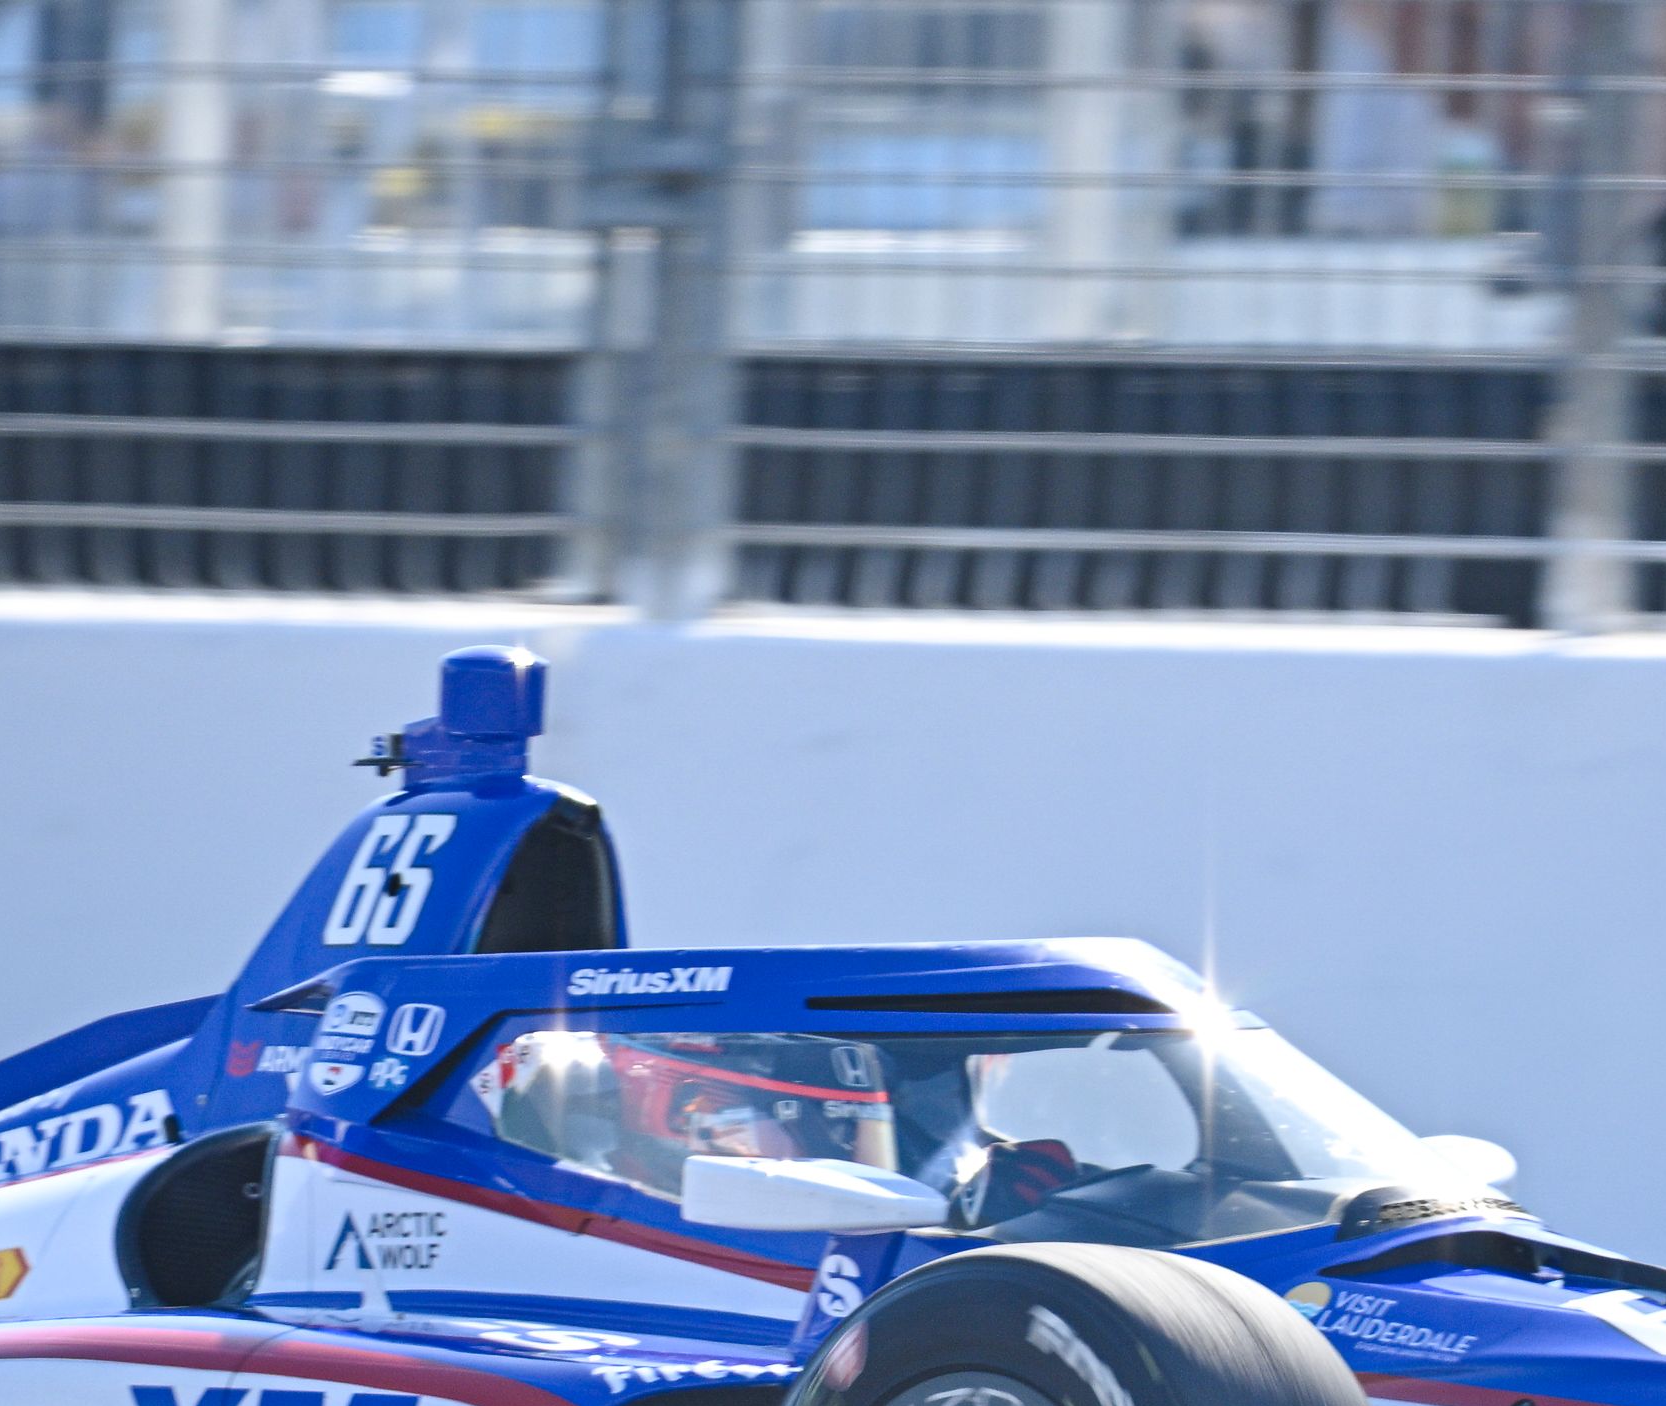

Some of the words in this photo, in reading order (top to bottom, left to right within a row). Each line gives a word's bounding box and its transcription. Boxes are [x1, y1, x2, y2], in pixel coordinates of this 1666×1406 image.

[323, 814, 457, 945] 66
[567, 966, 732, 996] SiriusXM
[367, 1212, 447, 1239] ARCTIC
[376, 1244, 440, 1270] WOLF
[1336, 1291, 1397, 1318] VISIT
[1317, 1309, 1477, 1353] LAUDERDALE
